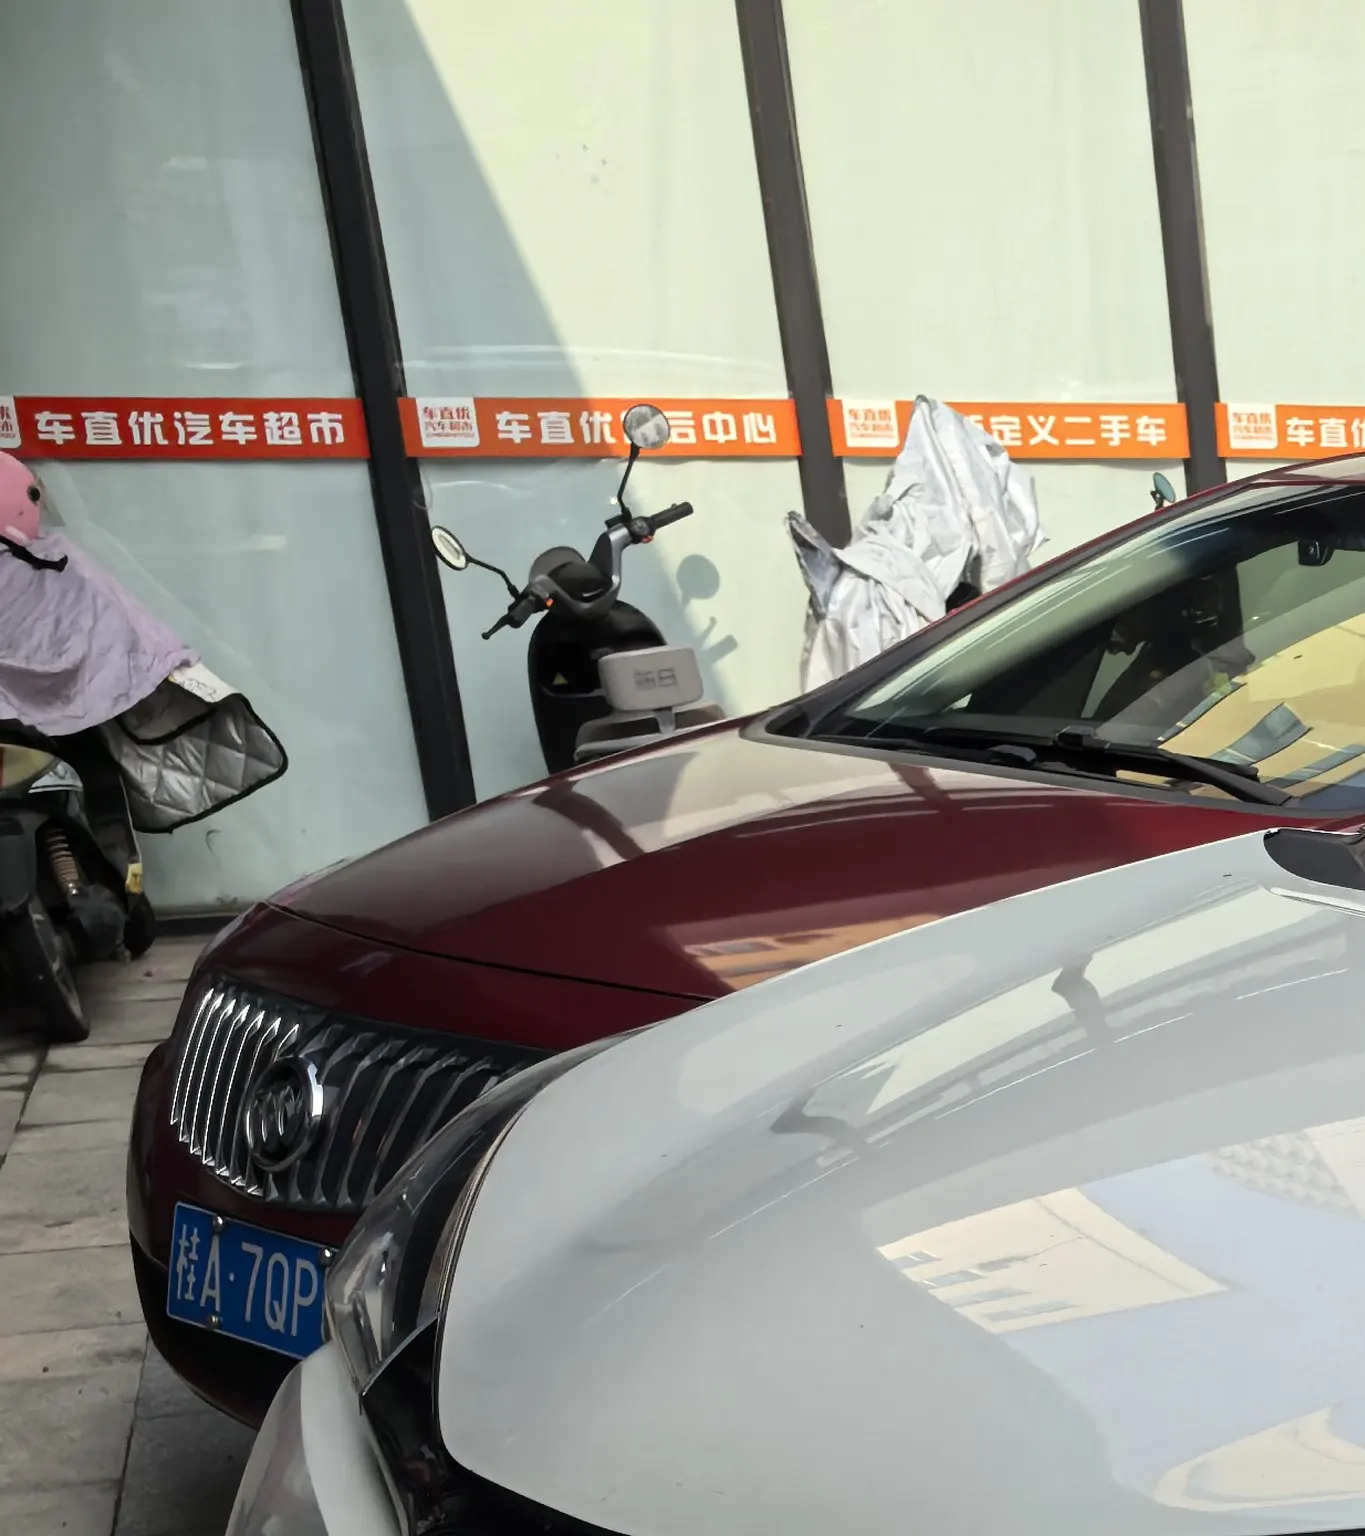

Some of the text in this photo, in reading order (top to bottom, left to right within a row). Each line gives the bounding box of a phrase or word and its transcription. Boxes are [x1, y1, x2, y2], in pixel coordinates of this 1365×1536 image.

[34, 410, 345, 445] 车直优汽车超市
[495, 410, 777, 444] 车直优后中心
[964, 414, 1166, 446] 定义二手车
